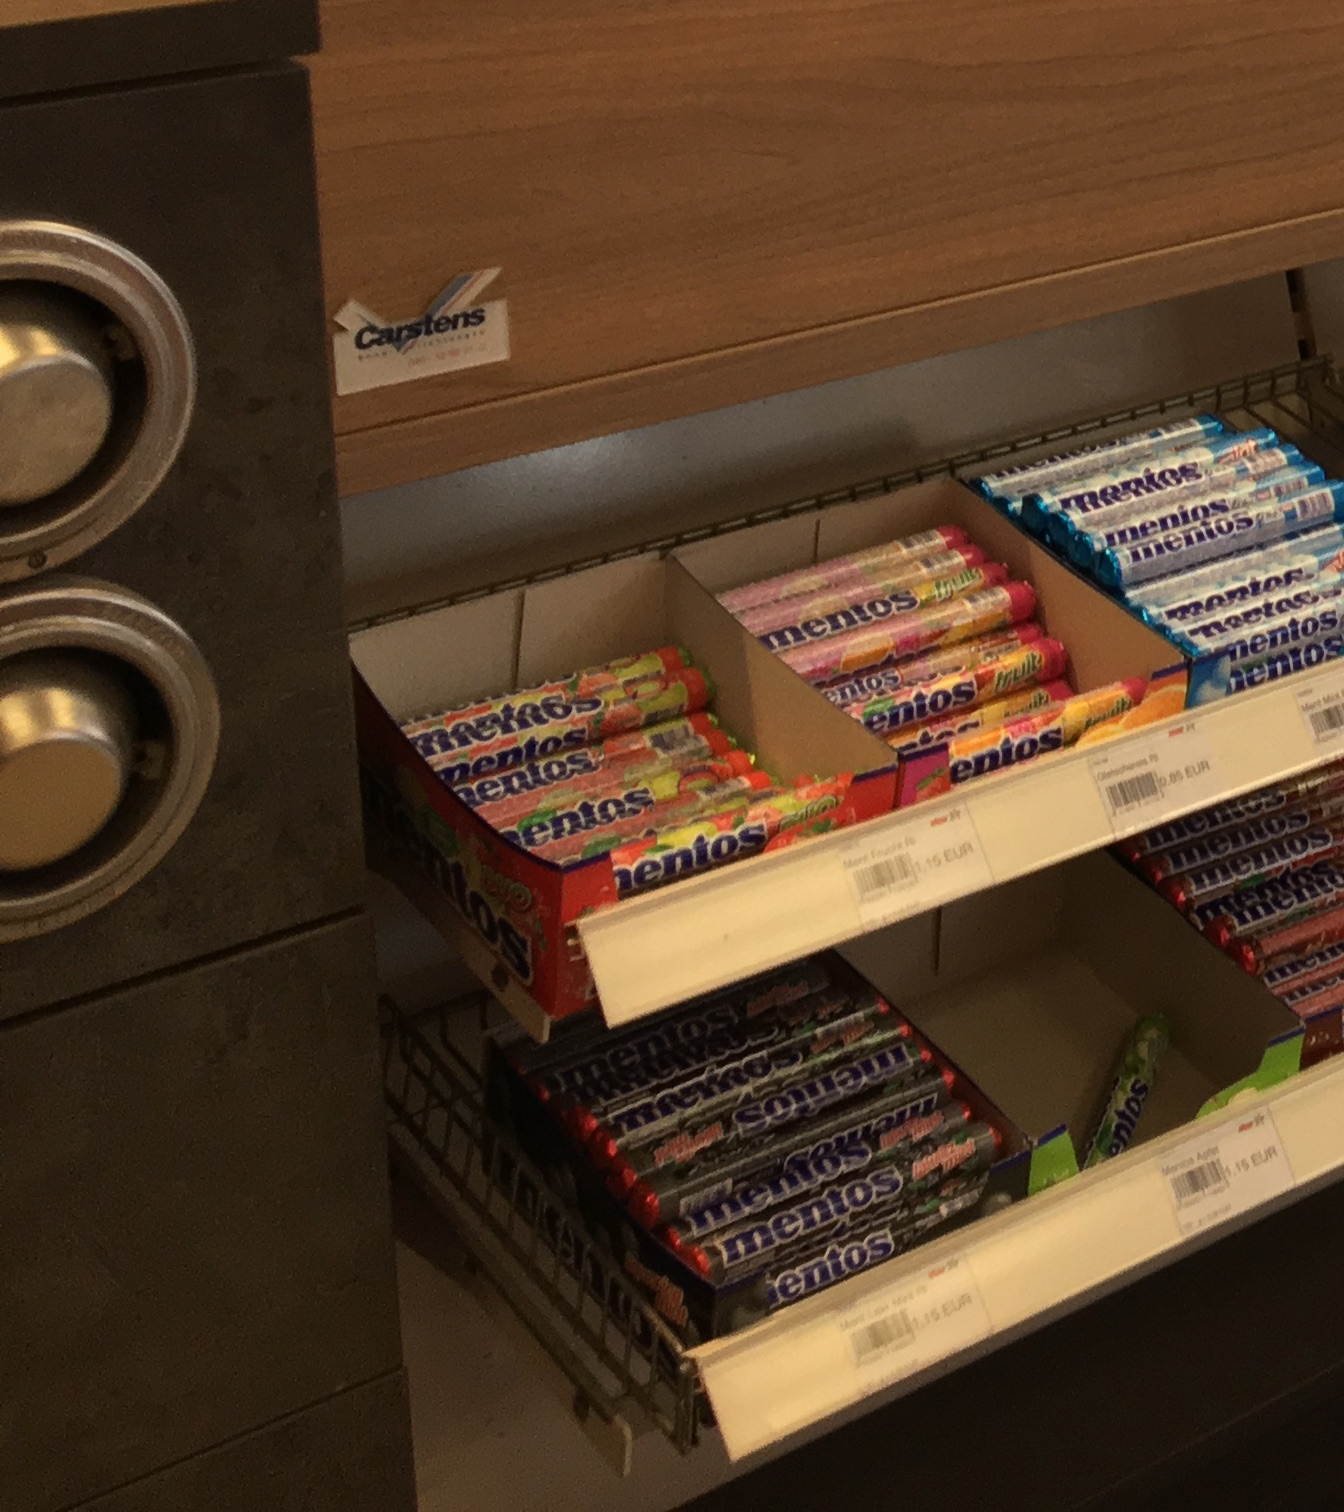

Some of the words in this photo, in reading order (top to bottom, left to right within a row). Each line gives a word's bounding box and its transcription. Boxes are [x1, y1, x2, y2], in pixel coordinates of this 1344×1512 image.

[354, 306, 488, 352] Carstens
[1127, 510, 1258, 566] mentos
[760, 589, 922, 652] mentos
[862, 677, 978, 732] entos
[949, 724, 1066, 786] entos
[1185, 759, 1212, 782] EUR
[942, 842, 974, 866] EUR
[1165, 812, 1310, 874] mentos
[1189, 827, 1334, 896] mentos
[1249, 1145, 1278, 1168] EUR
[719, 1165, 904, 1268] mentos
[768, 1228, 894, 1308] entos
